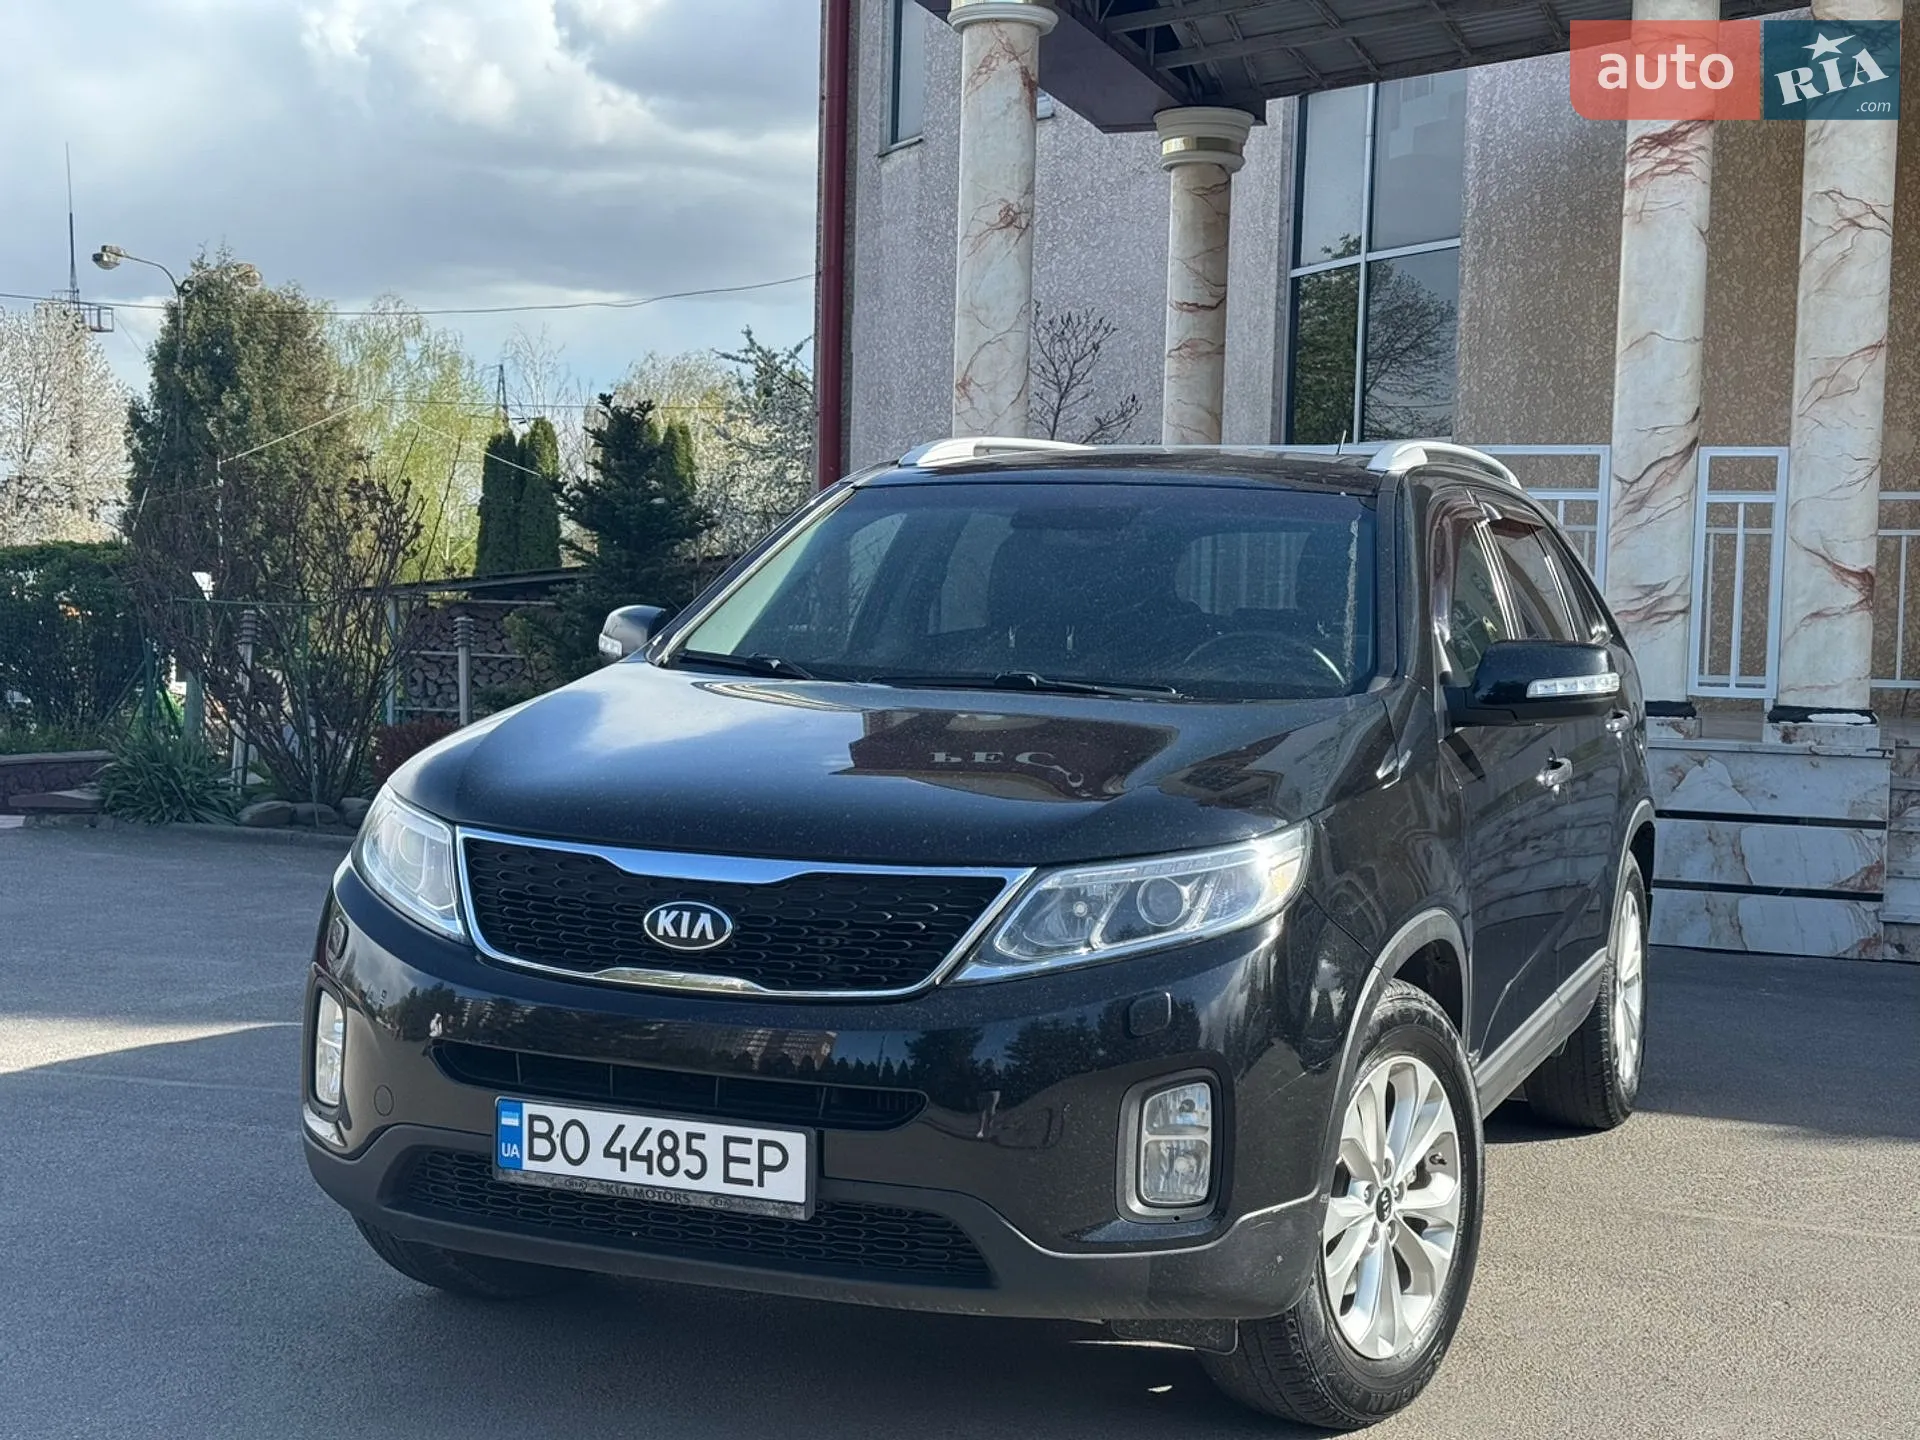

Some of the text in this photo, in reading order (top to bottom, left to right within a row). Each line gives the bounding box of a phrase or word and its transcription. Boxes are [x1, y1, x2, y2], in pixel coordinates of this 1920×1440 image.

[657, 910, 715, 940] KIA
[501, 1142, 520, 1159] UA
[528, 1113, 789, 1188] BO 4485 EP
[606, 1183, 692, 1204] KIA MOTORS
